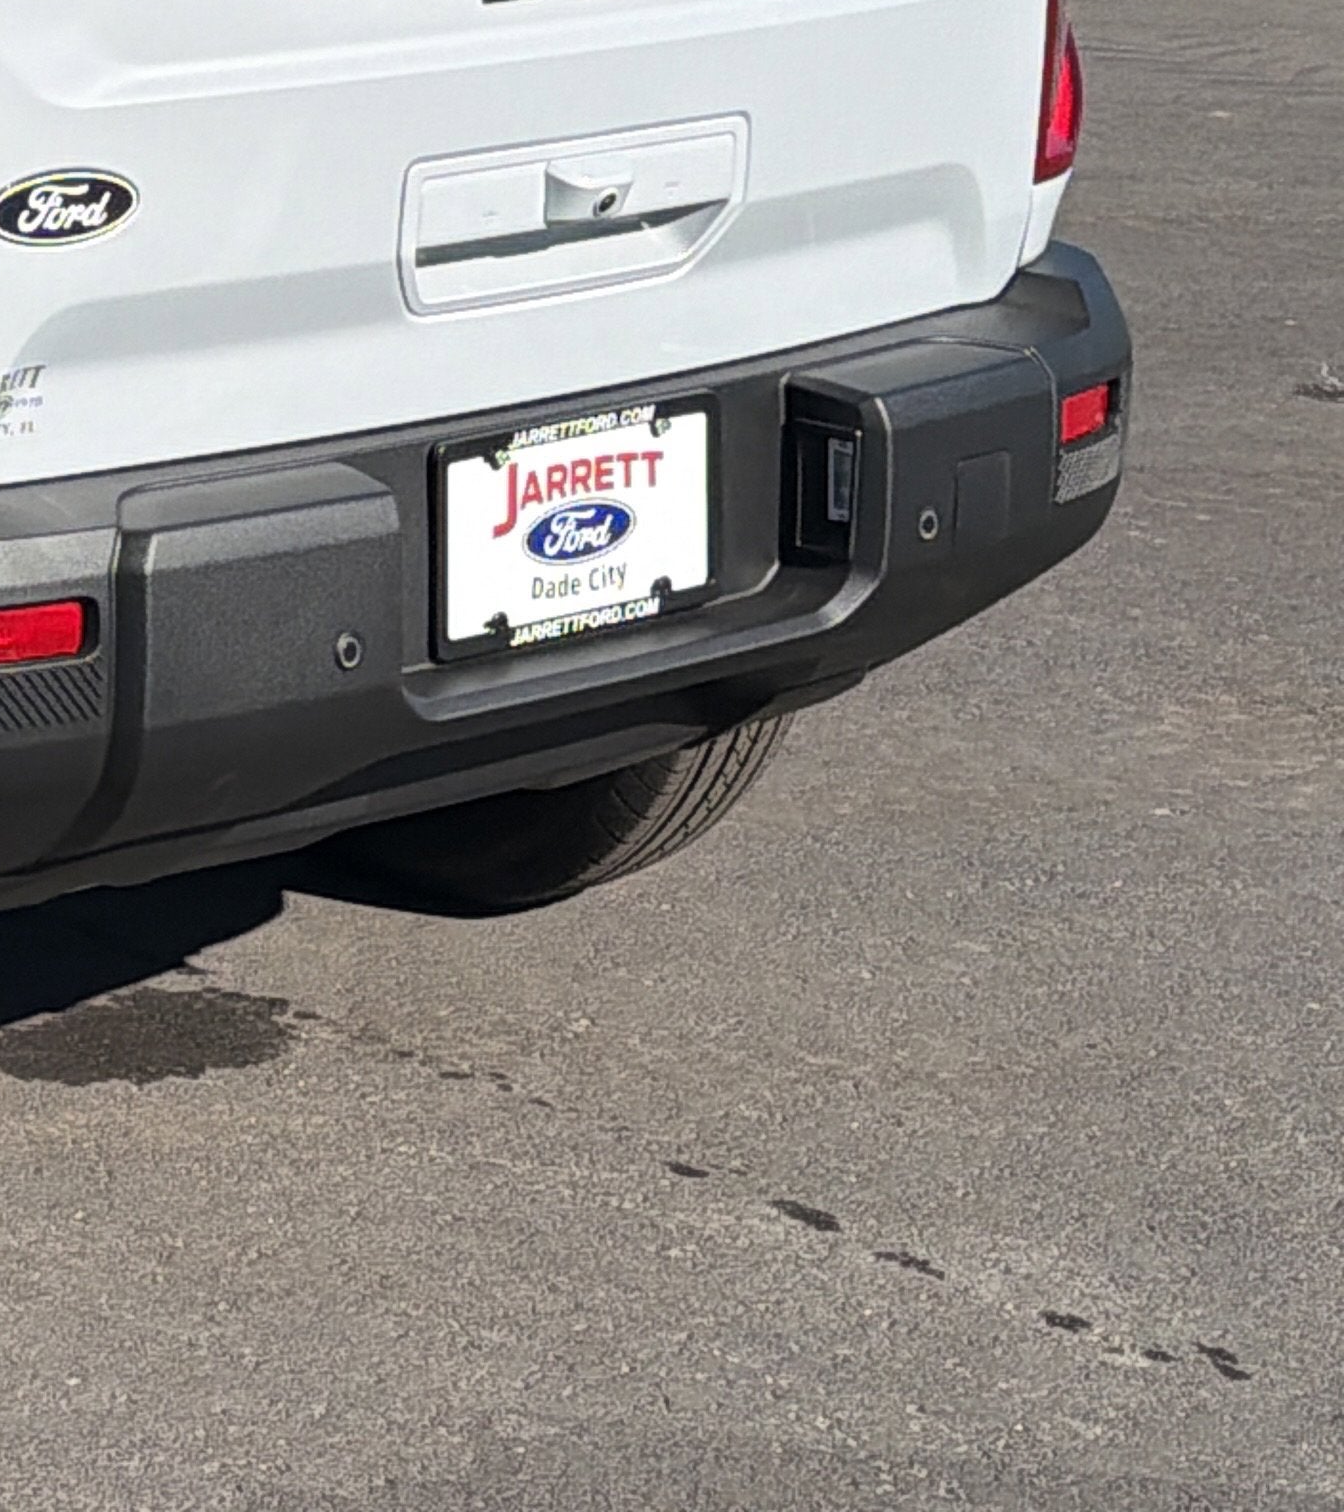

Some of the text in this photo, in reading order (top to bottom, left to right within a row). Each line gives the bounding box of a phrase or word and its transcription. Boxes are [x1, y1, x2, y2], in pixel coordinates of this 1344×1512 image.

[18, 183, 112, 234] Ford
[508, 405, 656, 450] JARRETTFORD.COM
[492, 451, 664, 538] JARRETT
[543, 506, 613, 557] Ford
[531, 563, 628, 600] Dade City
[509, 597, 661, 647] JARRETTFORD.COM
